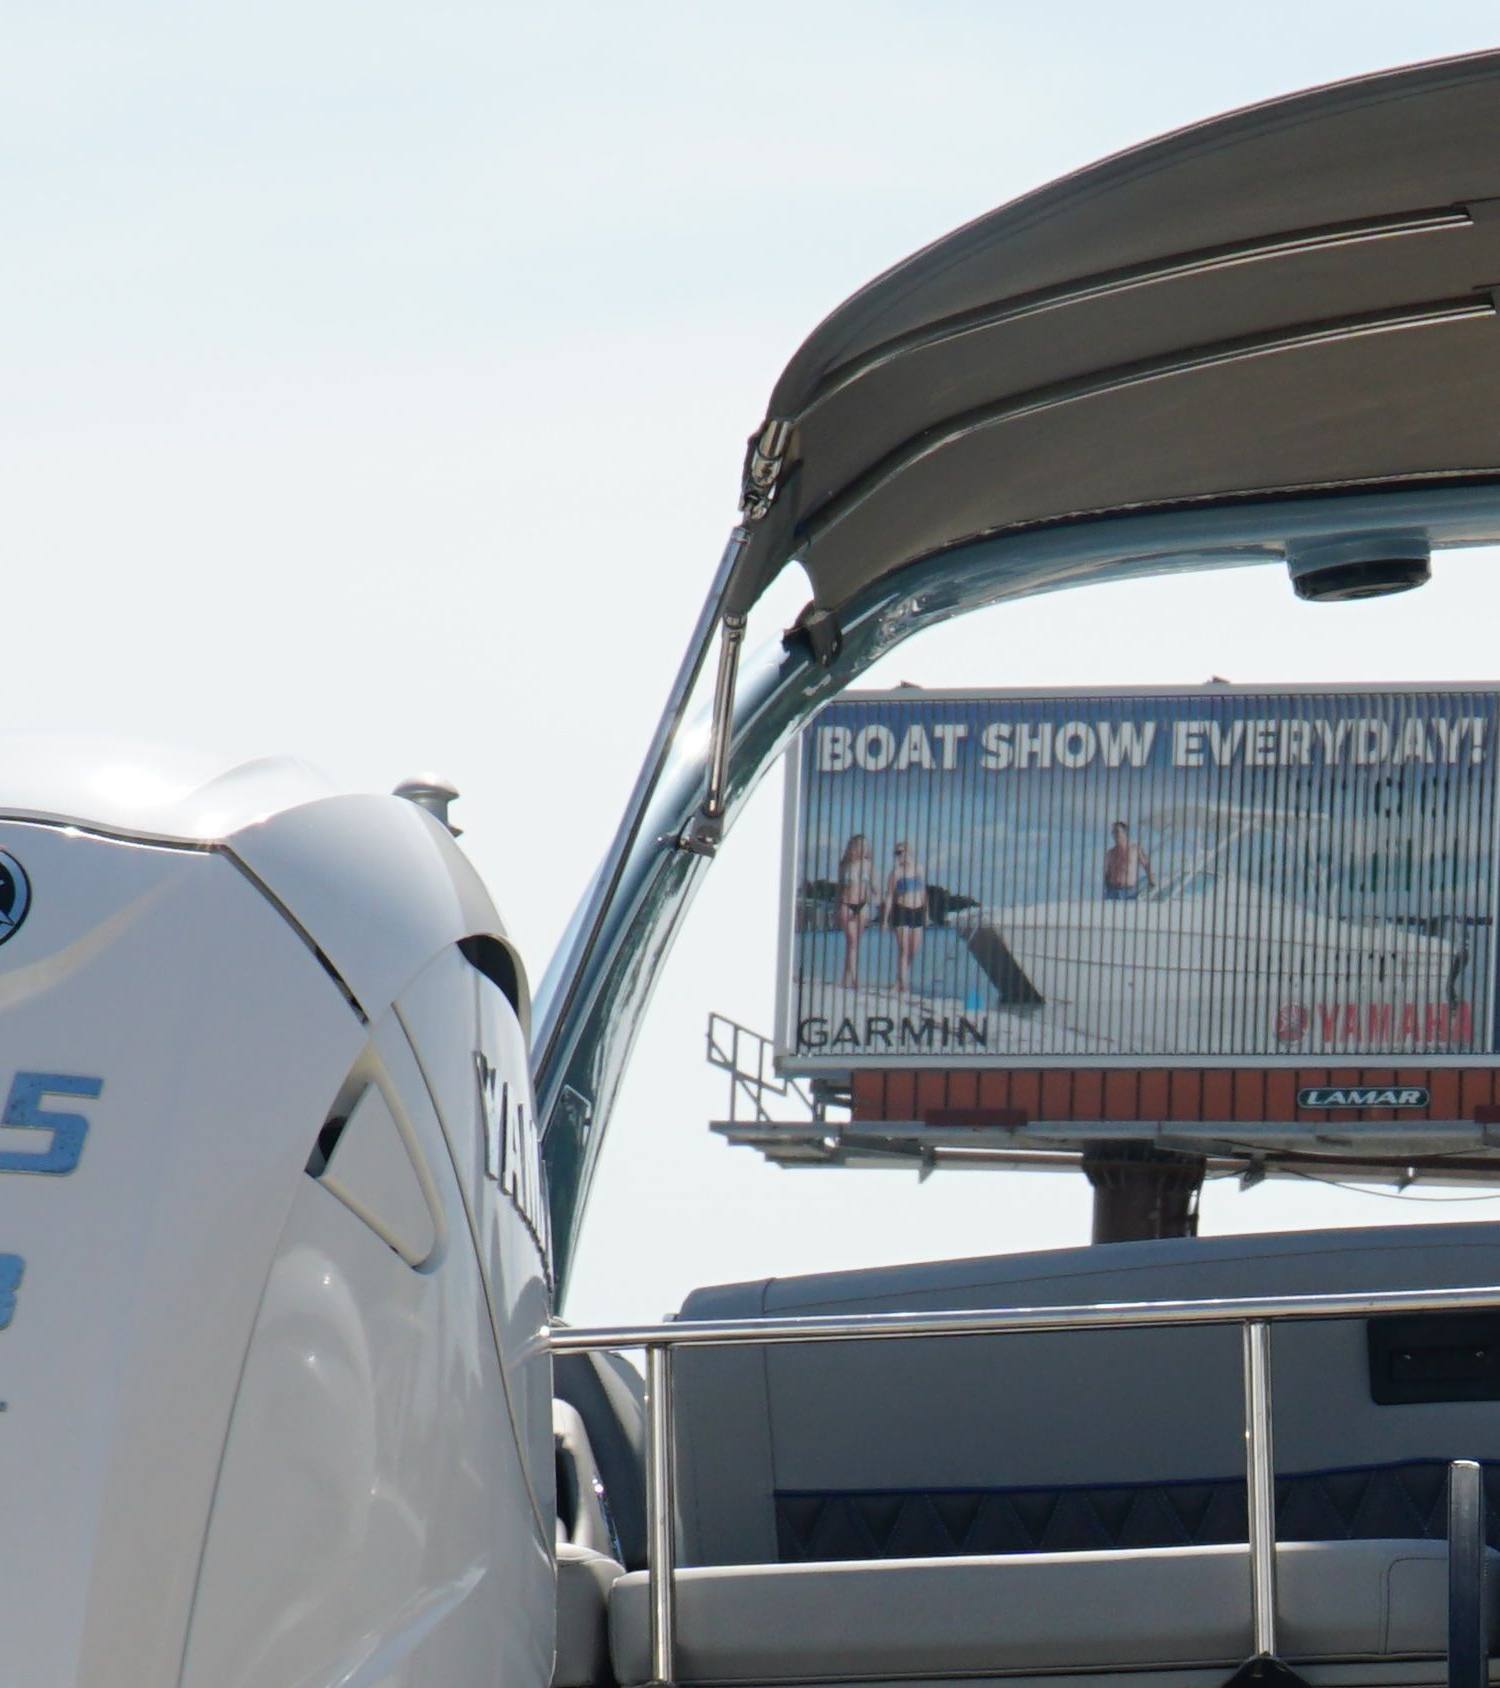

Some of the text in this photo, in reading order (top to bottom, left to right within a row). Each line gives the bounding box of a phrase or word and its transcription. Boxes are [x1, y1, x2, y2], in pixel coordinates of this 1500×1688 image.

[816, 717, 1488, 772] BOAT SHOW EVERYDAY!
[799, 1016, 988, 1048] GARMIN
[1317, 1003, 1472, 1042] YAMAHA
[1306, 1091, 1421, 1104] LAMAR
